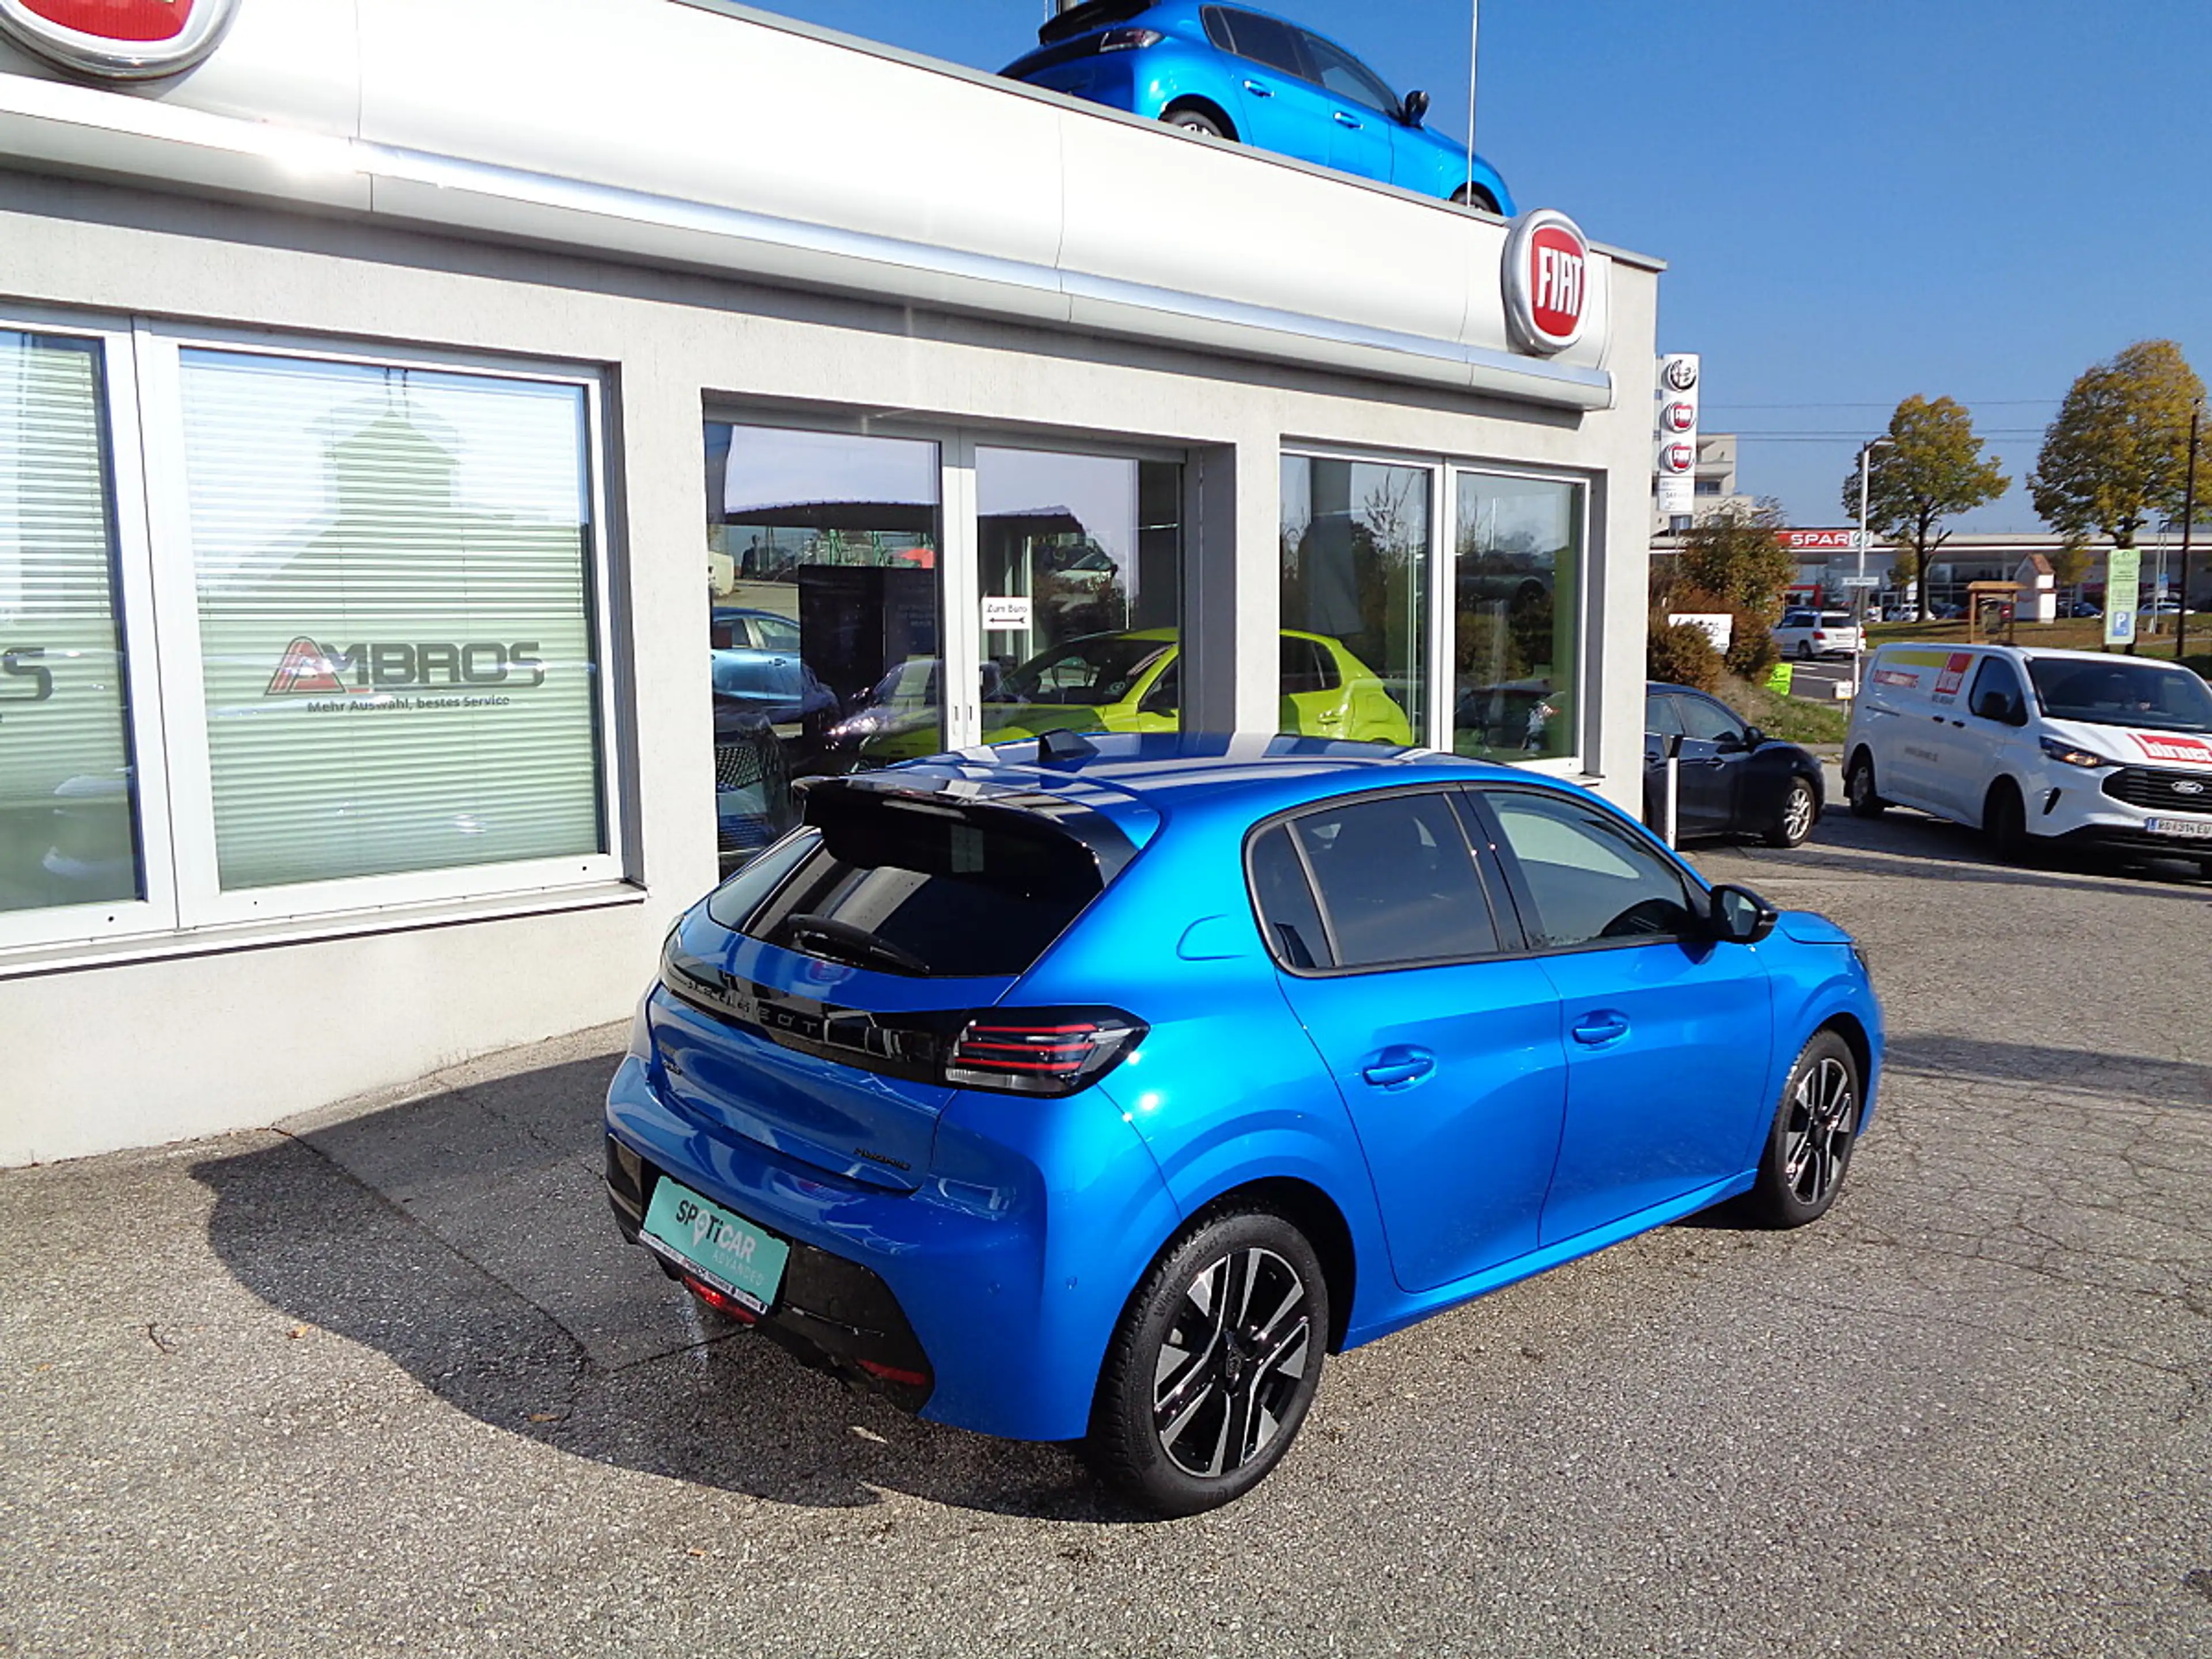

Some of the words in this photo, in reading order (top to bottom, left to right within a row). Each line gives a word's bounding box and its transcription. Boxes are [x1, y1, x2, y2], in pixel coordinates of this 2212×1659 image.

[1537, 246, 1584, 316] FIAT
[1790, 533, 1848, 545] SPAR
[986, 604, 1005, 613] Zum
[265, 636, 545, 695] AMBROS
[307, 701, 345, 713] Mehr
[349, 698, 412, 712] Auswahl,
[416, 696, 460, 709] bestes
[463, 694, 510, 707] Service
[712, 1250, 764, 1286] ADVANCED
